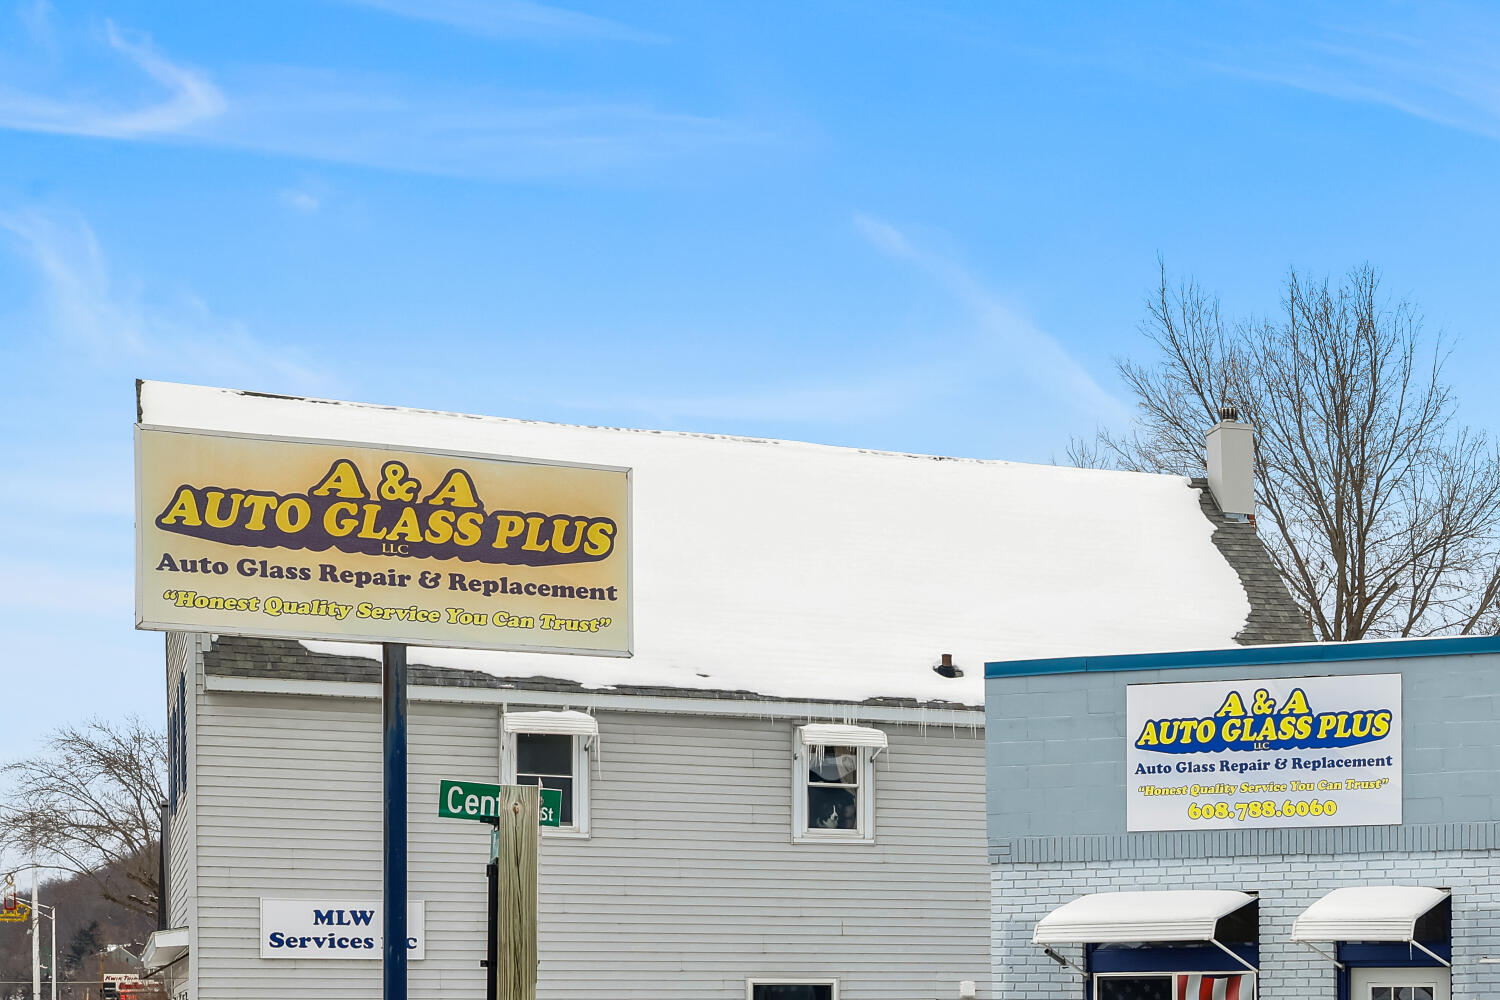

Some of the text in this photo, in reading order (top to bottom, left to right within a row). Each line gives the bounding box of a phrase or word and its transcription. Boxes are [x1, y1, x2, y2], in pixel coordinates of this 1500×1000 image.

[313, 461, 478, 508] A & A
[161, 488, 614, 556] AUTO GLASS PLUS
[382, 543, 409, 555] LLC
[156, 553, 618, 601] Auto Glass Repair & Replacement
[163, 589, 612, 633] “Honest Quality Service You Can Trust”
[1215, 689, 1310, 717] A & A
[1137, 712, 1392, 746] AUTO GLASS PLUS
[1253, 741, 1270, 750] LLC
[1134, 755, 1393, 775] Auto Glass Repair & Replacement
[1138, 777, 1390, 797] “Honest Quality Service You Can Trust”
[540, 806, 554, 822] St
[1187, 798, 1338, 821] 608.788.6060
[313, 909, 376, 926] MLW
[268, 931, 374, 949] Services
